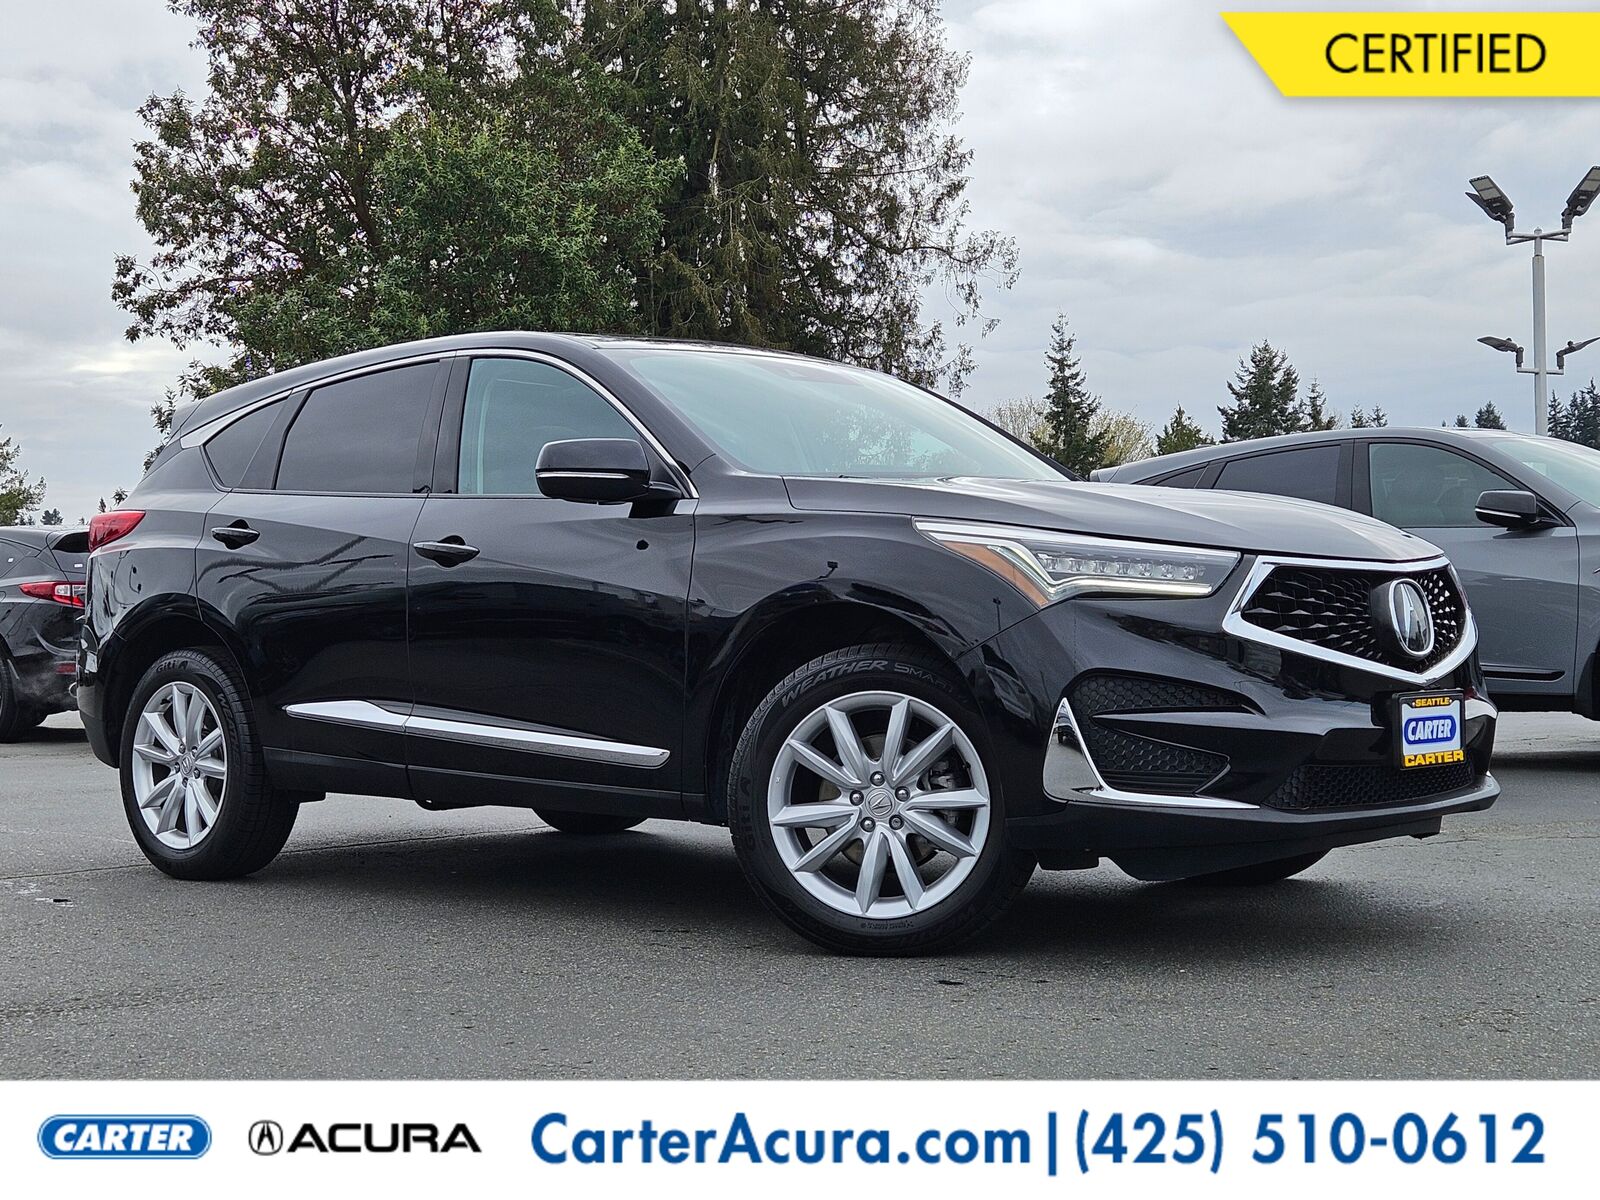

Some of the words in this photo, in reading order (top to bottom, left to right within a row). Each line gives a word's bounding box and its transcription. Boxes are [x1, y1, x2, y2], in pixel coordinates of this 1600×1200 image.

[781, 661, 888, 707] WEATHER
[1415, 697, 1450, 707] SEATTLE
[1407, 719, 1452, 741] CARTER
[1404, 750, 1464, 767] CARTER
